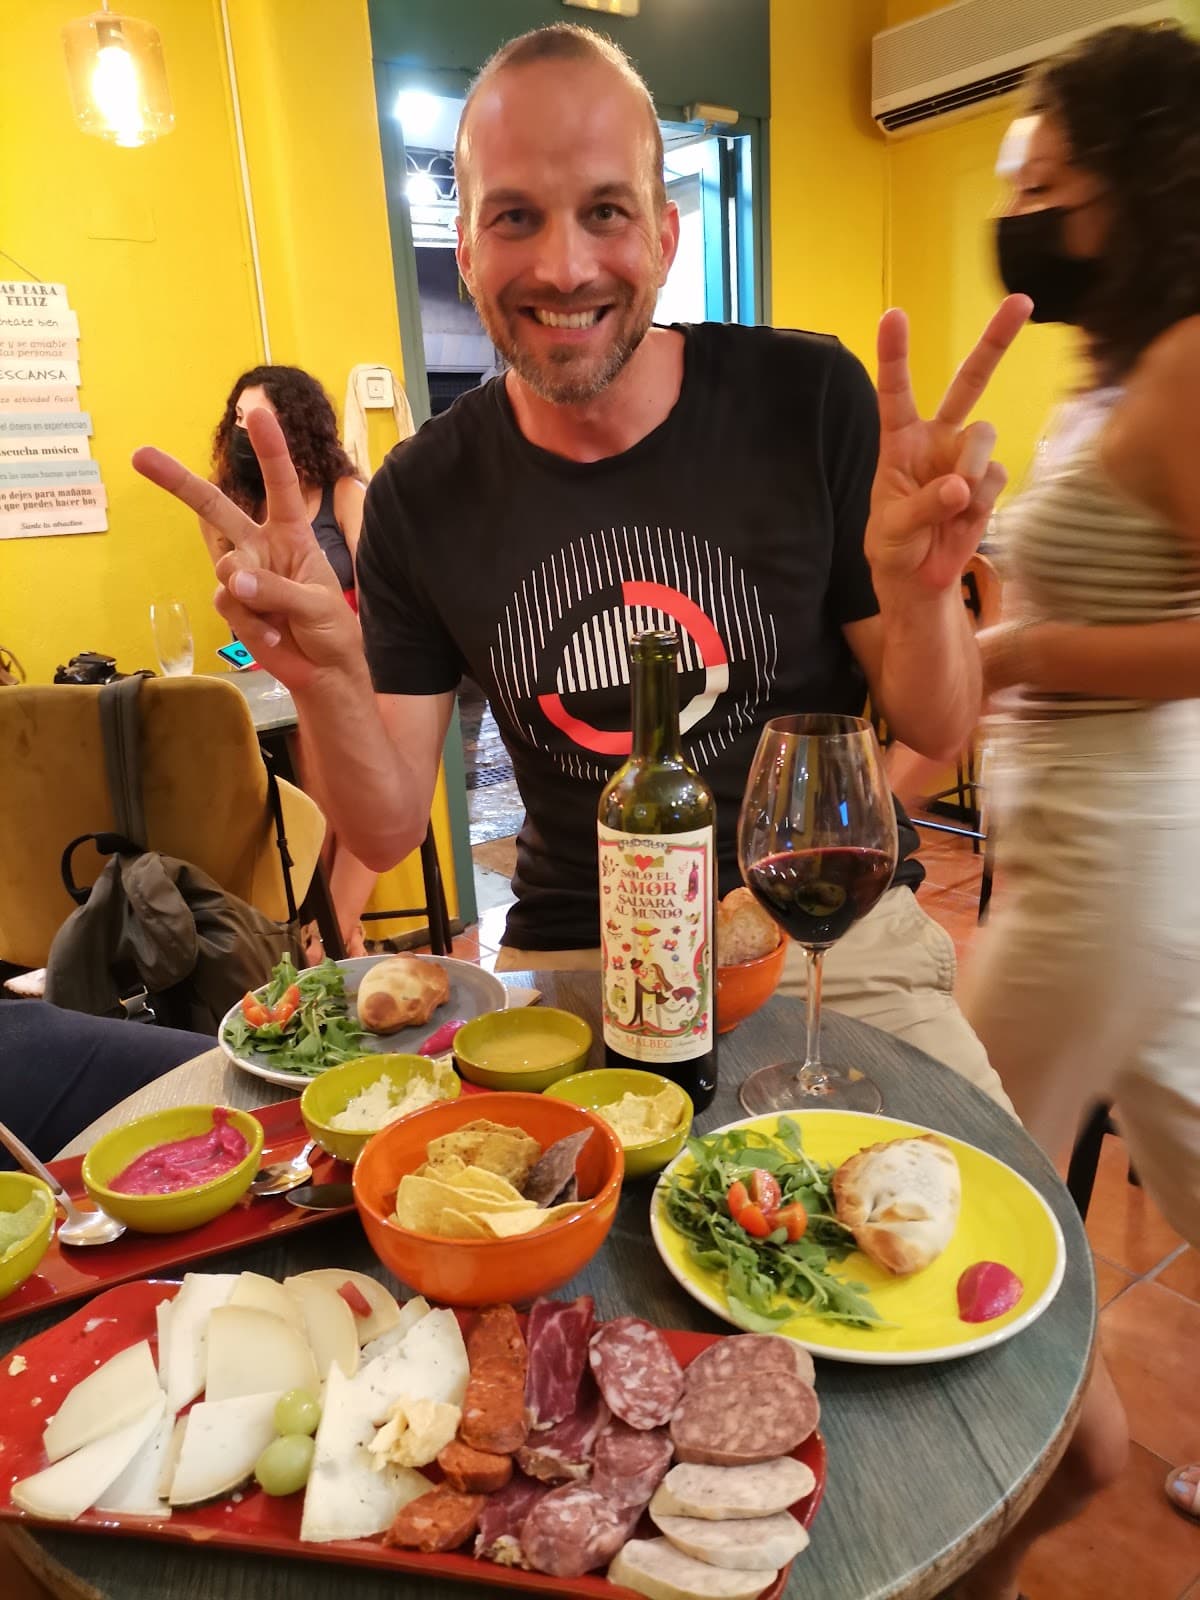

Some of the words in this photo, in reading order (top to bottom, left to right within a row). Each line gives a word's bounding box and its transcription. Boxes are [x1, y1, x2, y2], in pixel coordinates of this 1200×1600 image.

[7, 296, 48, 307] FELIZ
[0, 445, 39, 456] scucha
[41, 444, 79, 455] música
[35, 490, 55, 500] para
[58, 487, 92, 497] mañana
[4, 503, 20, 512] que
[23, 499, 53, 511] puedes
[621, 870, 653, 880] SOLO
[656, 871, 674, 881] EL
[617, 880, 677, 896] AMOR
[615, 903, 629, 916] AL
[632, 907, 683, 919] MUNDO
